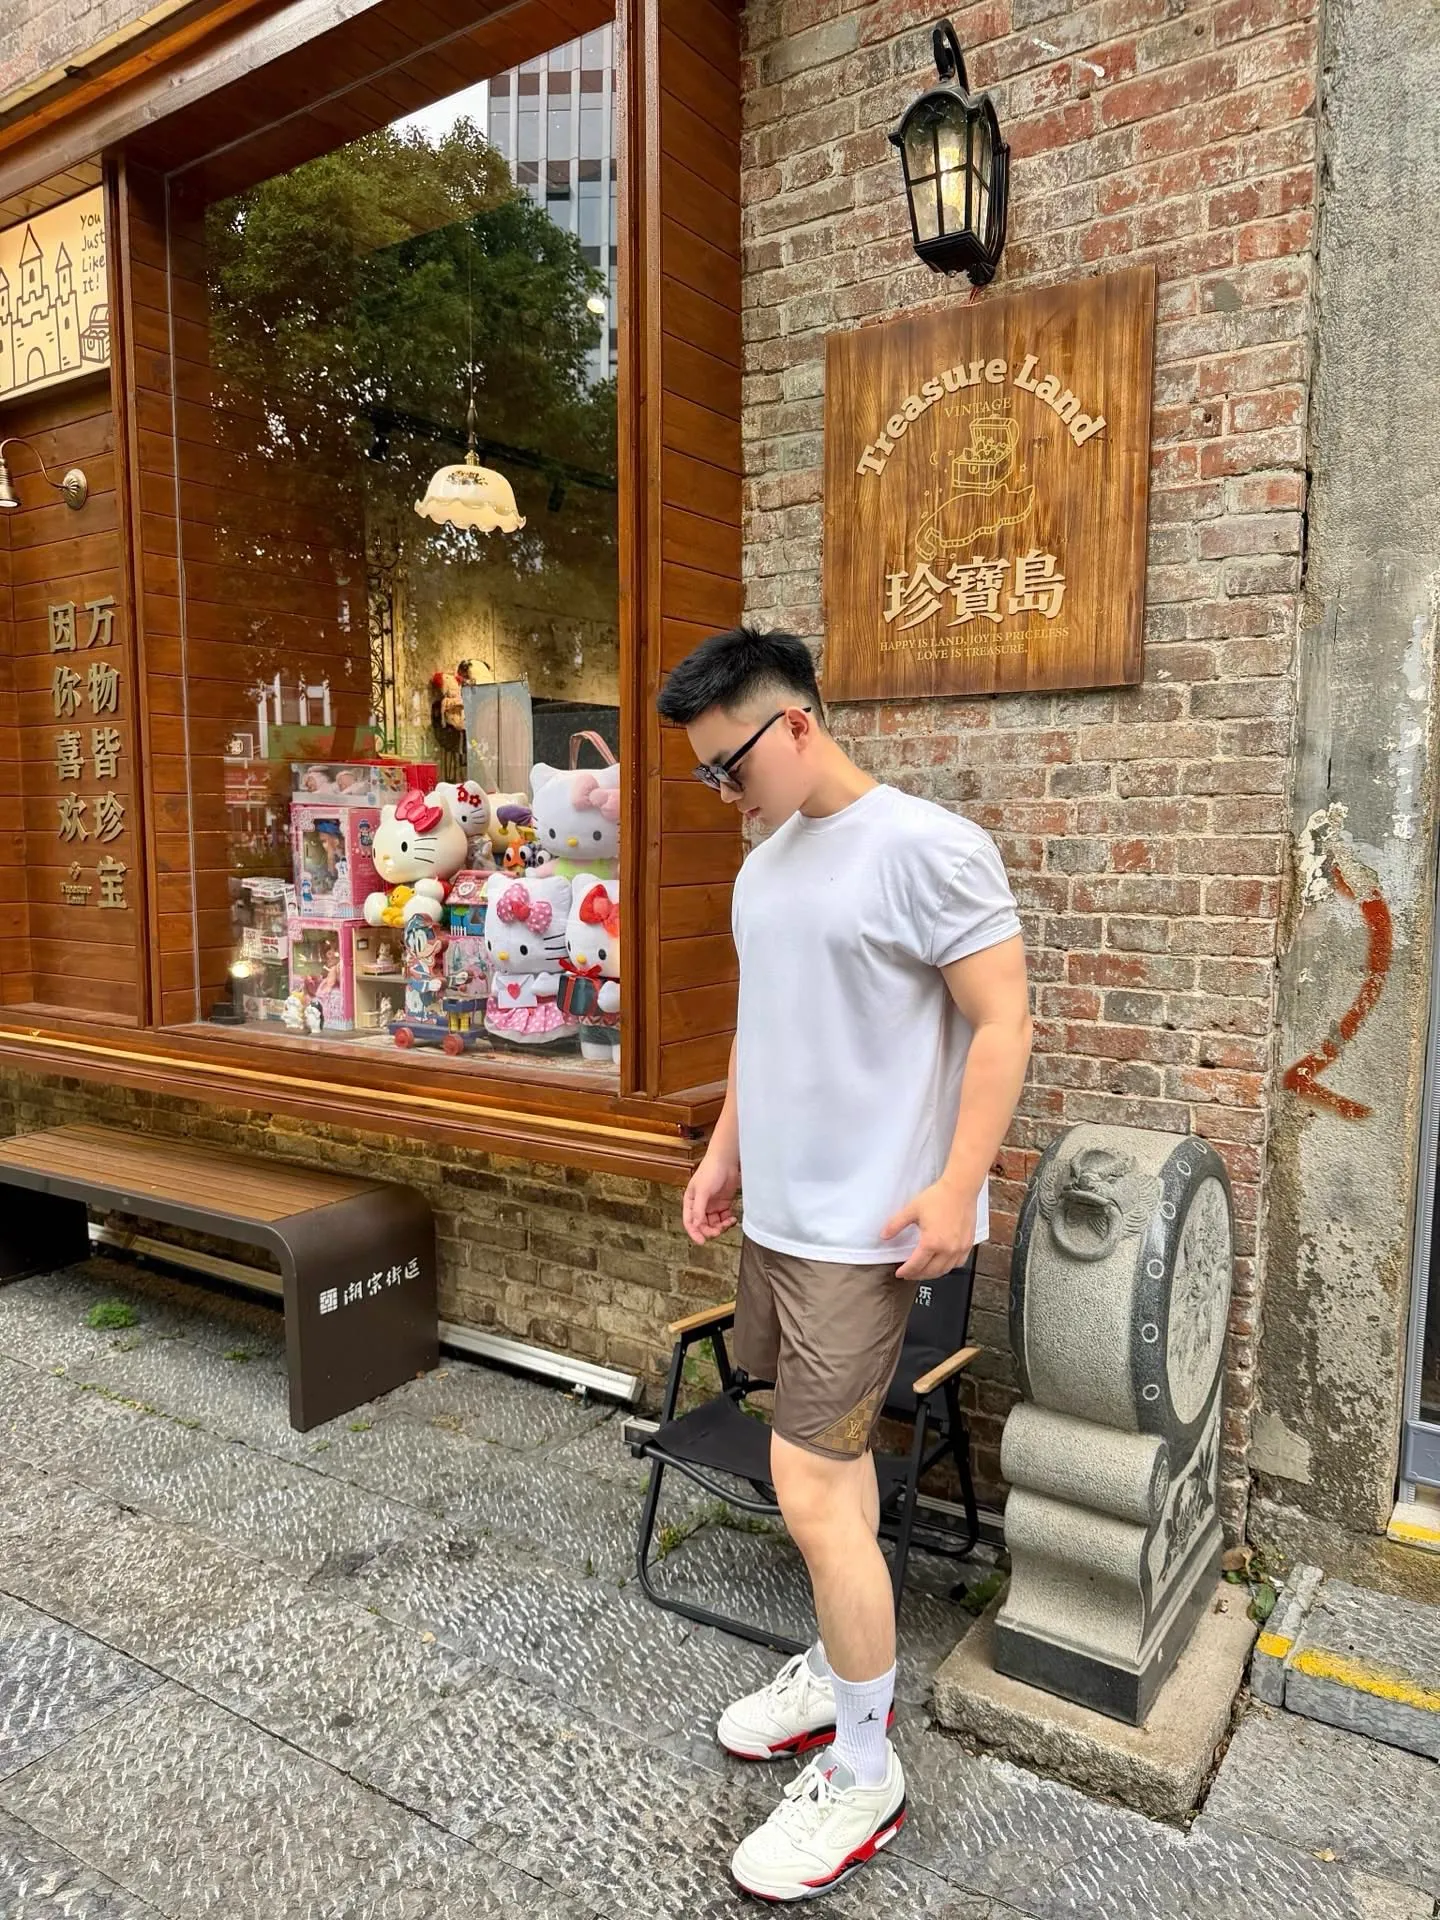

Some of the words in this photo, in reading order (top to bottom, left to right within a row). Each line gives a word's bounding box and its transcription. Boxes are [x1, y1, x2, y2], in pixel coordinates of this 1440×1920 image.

[81, 228, 105, 251] Just
[82, 254, 105, 272] Like
[83, 272, 99, 294] It!
[856, 358, 1008, 476] Treasure
[1013, 353, 1107, 447] Land
[944, 397, 1012, 418] VINTAGE
[883, 549, 1067, 631] 珍寶島
[880, 639, 916, 652] HAPPY
[918, 637, 928, 648] IS
[931, 635, 967, 648] LAND,
[968, 633, 990, 646] JOY
[992, 632, 1002, 643] IS
[1005, 627, 1069, 642] PRICELESS
[917, 650, 948, 661] LOVE
[951, 648, 961, 659] IS
[965, 643, 1028, 658] TREASURE.
[48, 600, 89, 842] 因你喜欢
[85, 595, 128, 908] 万物皆珍宝
